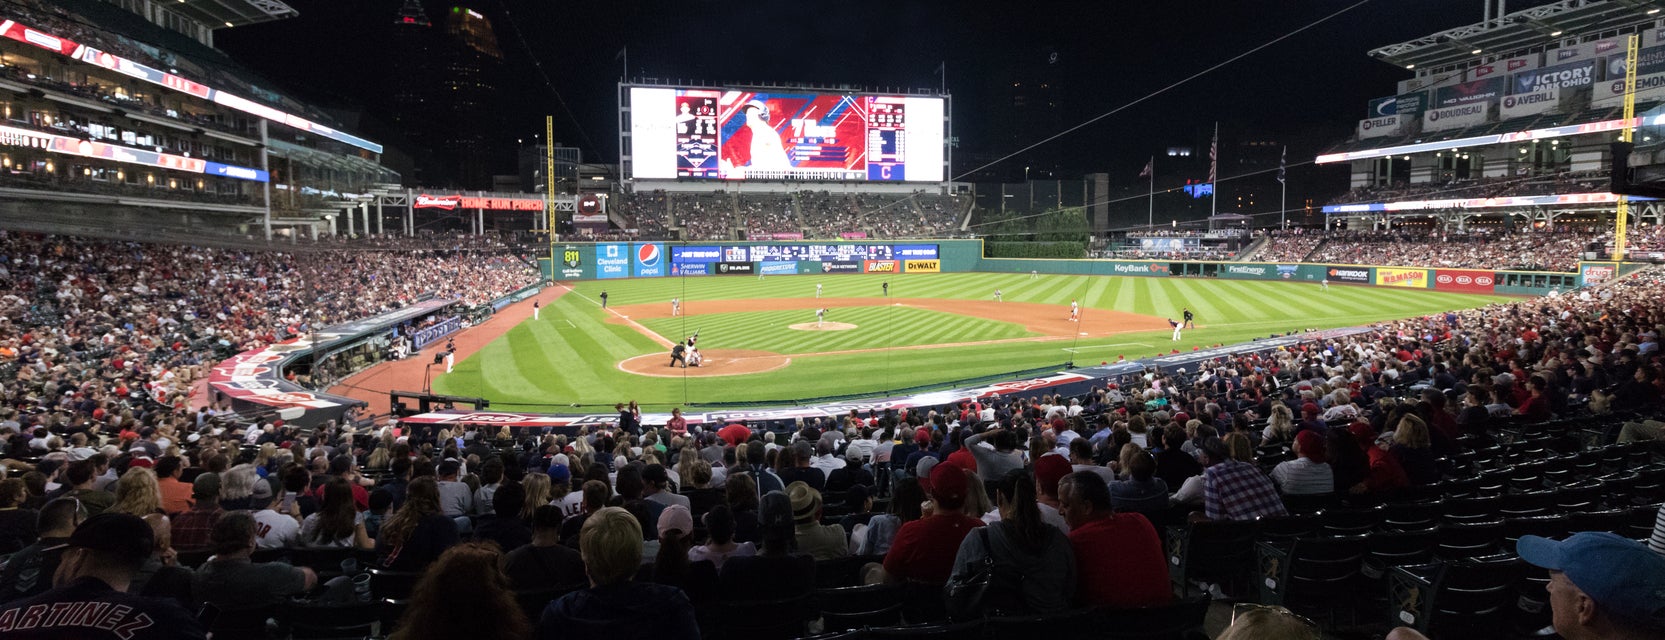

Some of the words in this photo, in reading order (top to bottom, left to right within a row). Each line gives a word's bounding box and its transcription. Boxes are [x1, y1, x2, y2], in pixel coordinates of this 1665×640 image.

[1520, 65, 1593, 87] VICTORY
[1635, 75, 1665, 89] EMON
[1533, 81, 1560, 92] PARK
[1561, 76, 1591, 88] OHIO
[1458, 91, 1496, 102] VAUGHN
[1517, 92, 1555, 106] AVERILL
[1439, 105, 1482, 119] BOUDREAU
[1371, 117, 1396, 128] FELLER
[461, 197, 489, 209] HOME
[491, 199, 510, 210] RUN
[512, 200, 544, 210] PORCH
[564, 250, 579, 262] 811
[868, 262, 895, 272] BLASTER
[1114, 264, 1149, 273] KeyBank
[1229, 265, 1265, 274] FirstEnergy
[1585, 266, 1608, 278] drug
[0, 602, 154, 640] ARTINEZ
